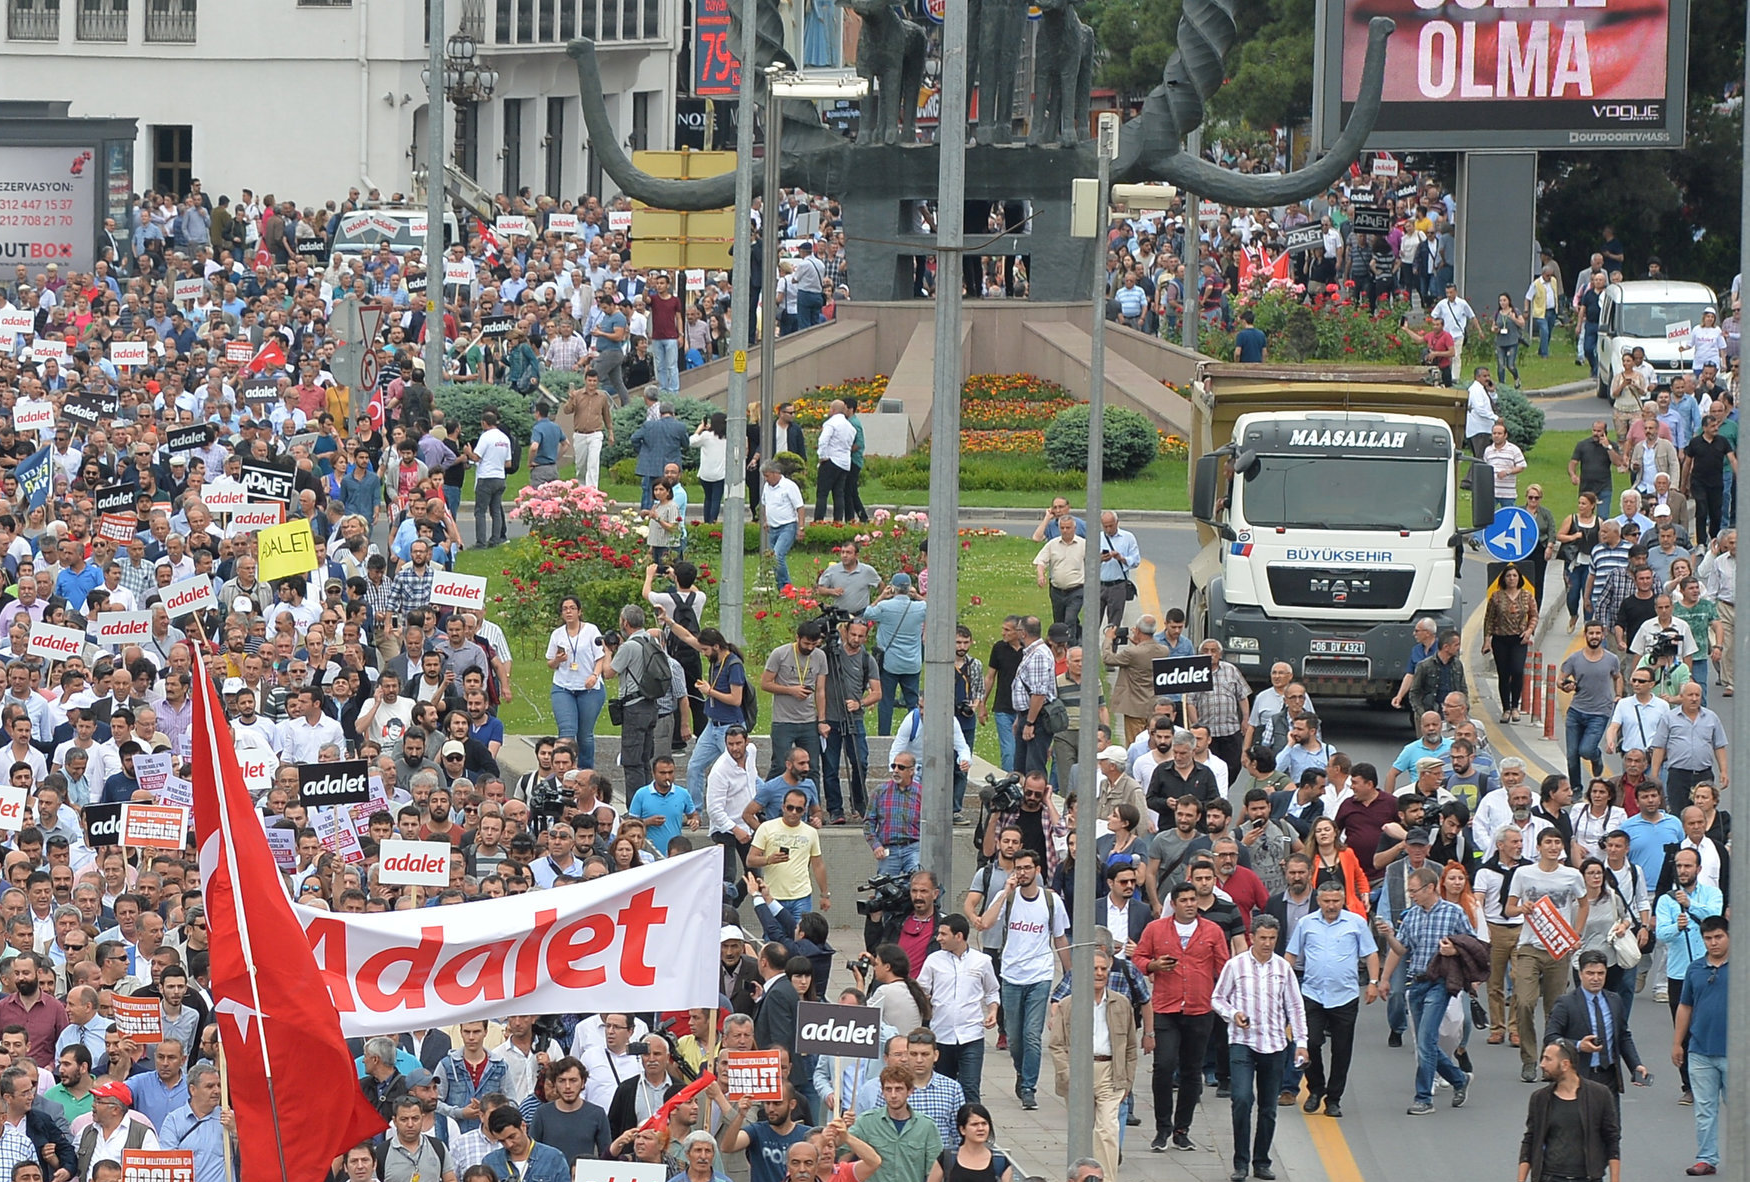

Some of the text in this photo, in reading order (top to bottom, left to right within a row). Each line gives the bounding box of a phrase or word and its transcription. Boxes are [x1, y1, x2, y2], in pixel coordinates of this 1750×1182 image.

[701, 32, 731, 81] 79
[1418, 20, 1593, 98] OLMA
[0, 200, 18, 209] 312
[21, 200, 41, 209] 447
[44, 200, 57, 209] 15
[60, 200, 73, 209] 37
[0, 216, 18, 226] 212
[21, 216, 41, 226] 708
[44, 216, 57, 226] 21
[59, 216, 73, 226] 70
[551, 220, 576, 228] adalet
[1288, 229, 1322, 245] ADALET
[299, 242, 324, 250] adalet
[448, 270, 470, 278] adalet
[177, 284, 202, 295] adalet
[2, 316, 31, 327] adalet
[1668, 327, 1690, 338] adalet
[34, 347, 63, 358] adalet
[114, 349, 144, 359] adalet
[245, 385, 277, 398] adalet
[16, 410, 50, 423] adalet
[63, 403, 98, 422] adalet
[170, 432, 206, 447] adalet
[242, 470, 292, 498] ADALET
[98, 492, 134, 508] adalet
[204, 492, 244, 504] adalet
[235, 512, 276, 524] adalet
[261, 531, 310, 560] ADALET
[434, 583, 481, 599] adalet
[1310, 579, 1370, 592] MAN
[167, 584, 210, 609] adalet
[101, 621, 148, 635] adalet
[32, 635, 80, 653] adalet
[1317, 642, 1326, 651] 06
[1344, 643, 1364, 652] 4321
[1156, 666, 1210, 686] adalet
[303, 773, 366, 795] adalet
[384, 854, 445, 874] adalet
[1009, 920, 1046, 937] adalet
[303, 887, 668, 1012] Adalet
[801, 1018, 877, 1046] adalet
